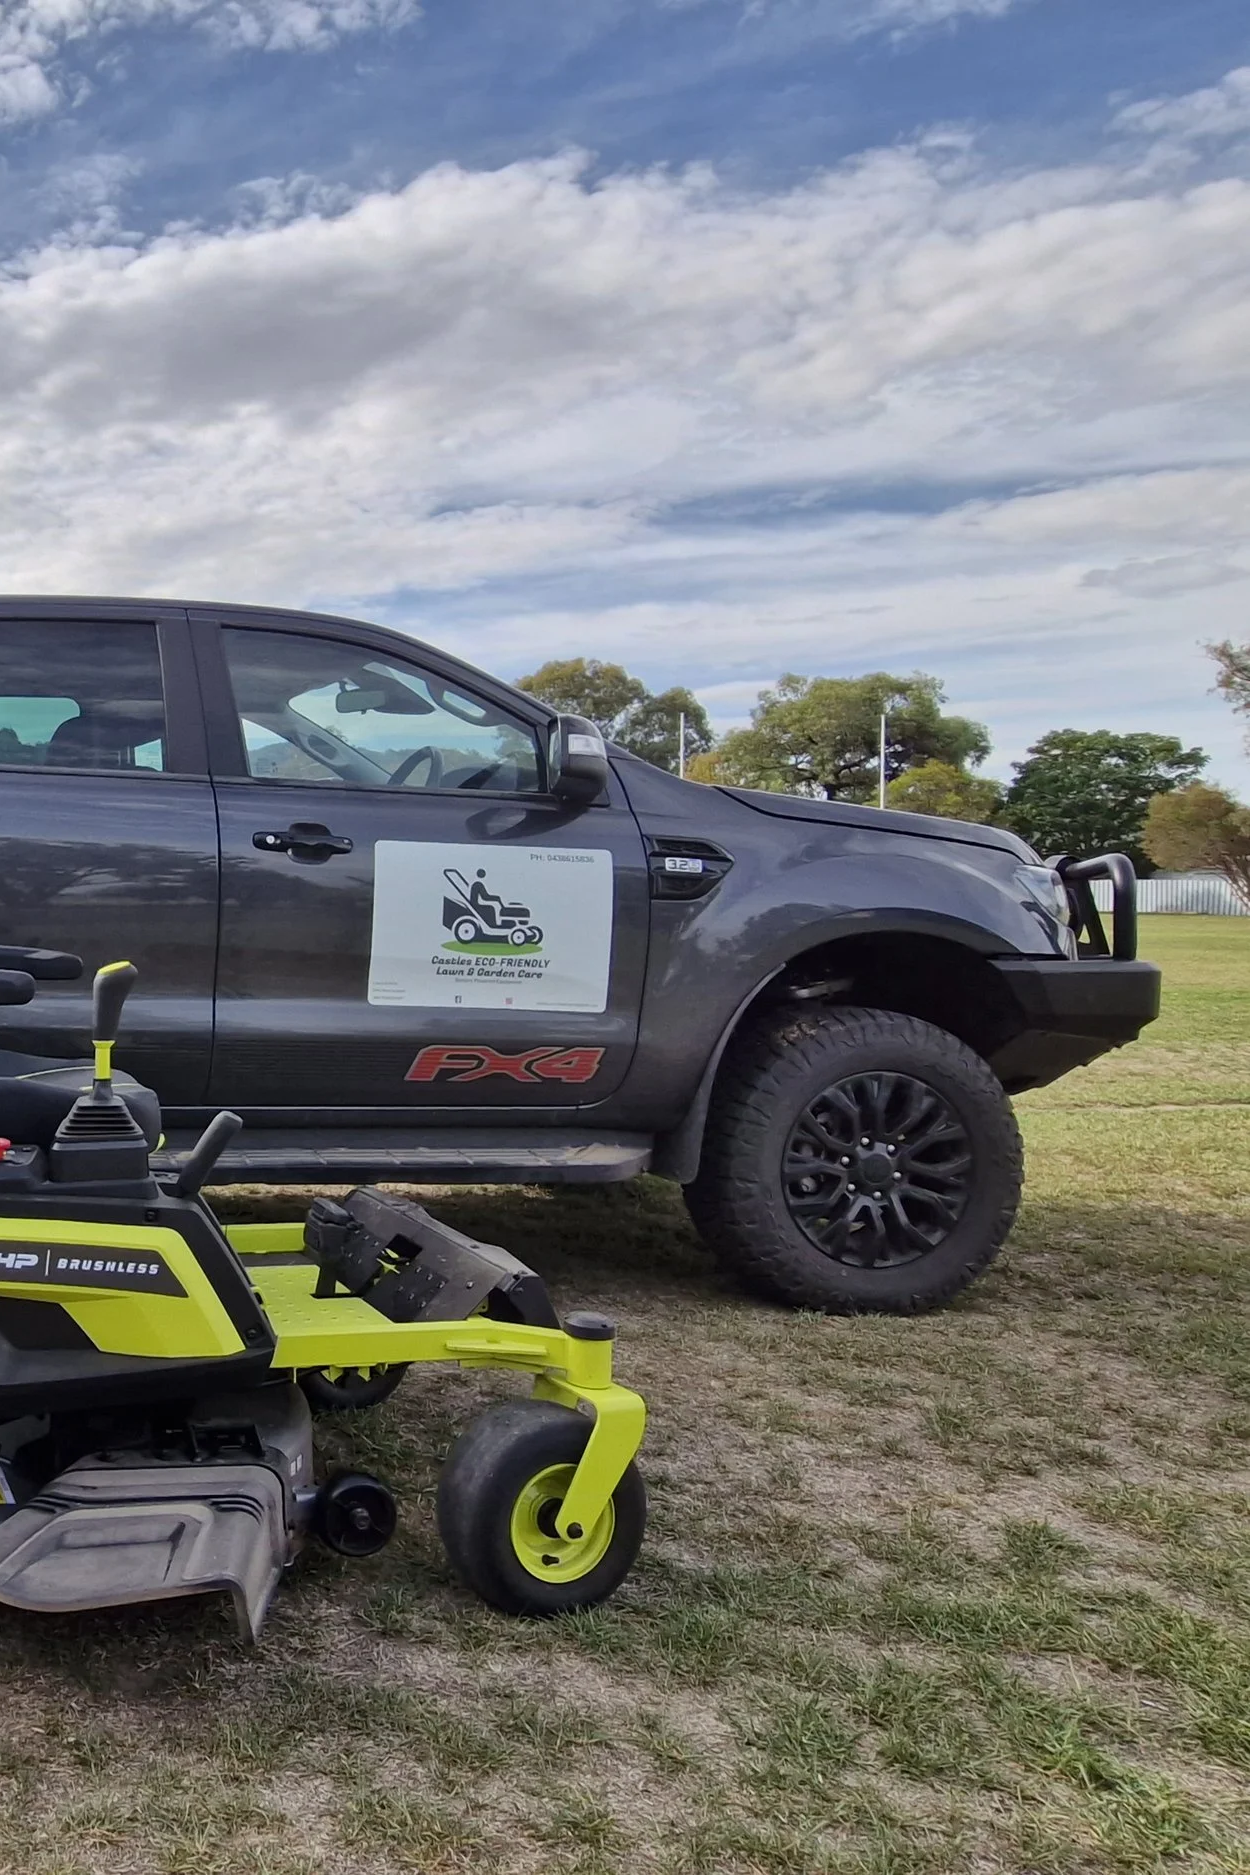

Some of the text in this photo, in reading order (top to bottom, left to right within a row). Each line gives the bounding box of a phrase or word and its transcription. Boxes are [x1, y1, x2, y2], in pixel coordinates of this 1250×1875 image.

[431, 956, 550, 968] Castles ECO-FRIENDLY
[436, 966, 543, 979] Lawn & Garden Care
[404, 1044, 606, 1083] FX4
[57, 1258, 159, 1275] BRUSHLESS
